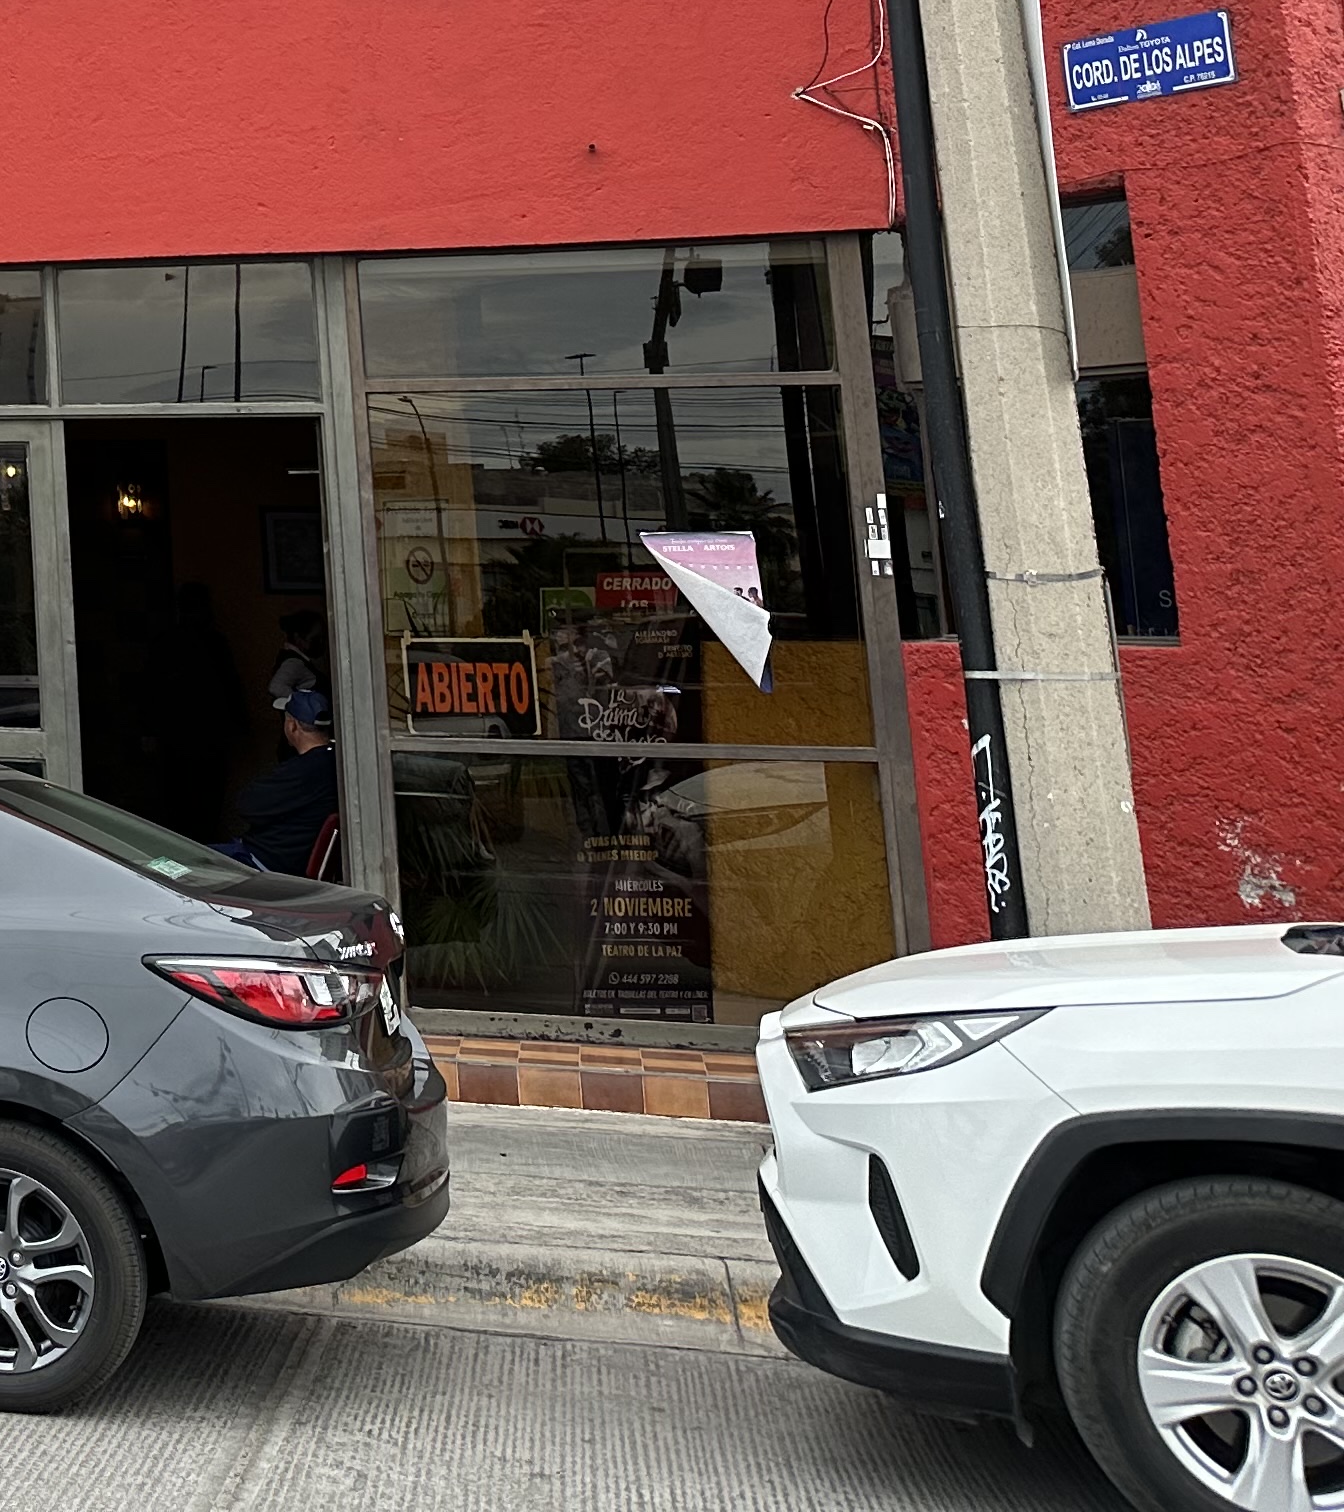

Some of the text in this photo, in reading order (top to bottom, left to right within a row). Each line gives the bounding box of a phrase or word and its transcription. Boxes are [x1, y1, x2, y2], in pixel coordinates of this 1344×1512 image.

[1139, 36, 1171, 49] TOYOTA
[1072, 59, 1118, 89] CORD.
[1119, 54, 1141, 80] DE
[1142, 47, 1172, 76] LOS
[1176, 37, 1224, 70] ALPES
[603, 577, 673, 591] CERRADO
[416, 662, 529, 714] ABIERTO
[578, 698, 650, 735] Dama
[618, 834, 651, 846] VENIR
[590, 897, 692, 917] 2 NOVIEMBRE
[604, 922, 627, 934] 7:00
[638, 922, 660, 934] 9:30
[664, 923, 678, 935] PM
[602, 944, 683, 957] TEATRO DE LA PAZ
